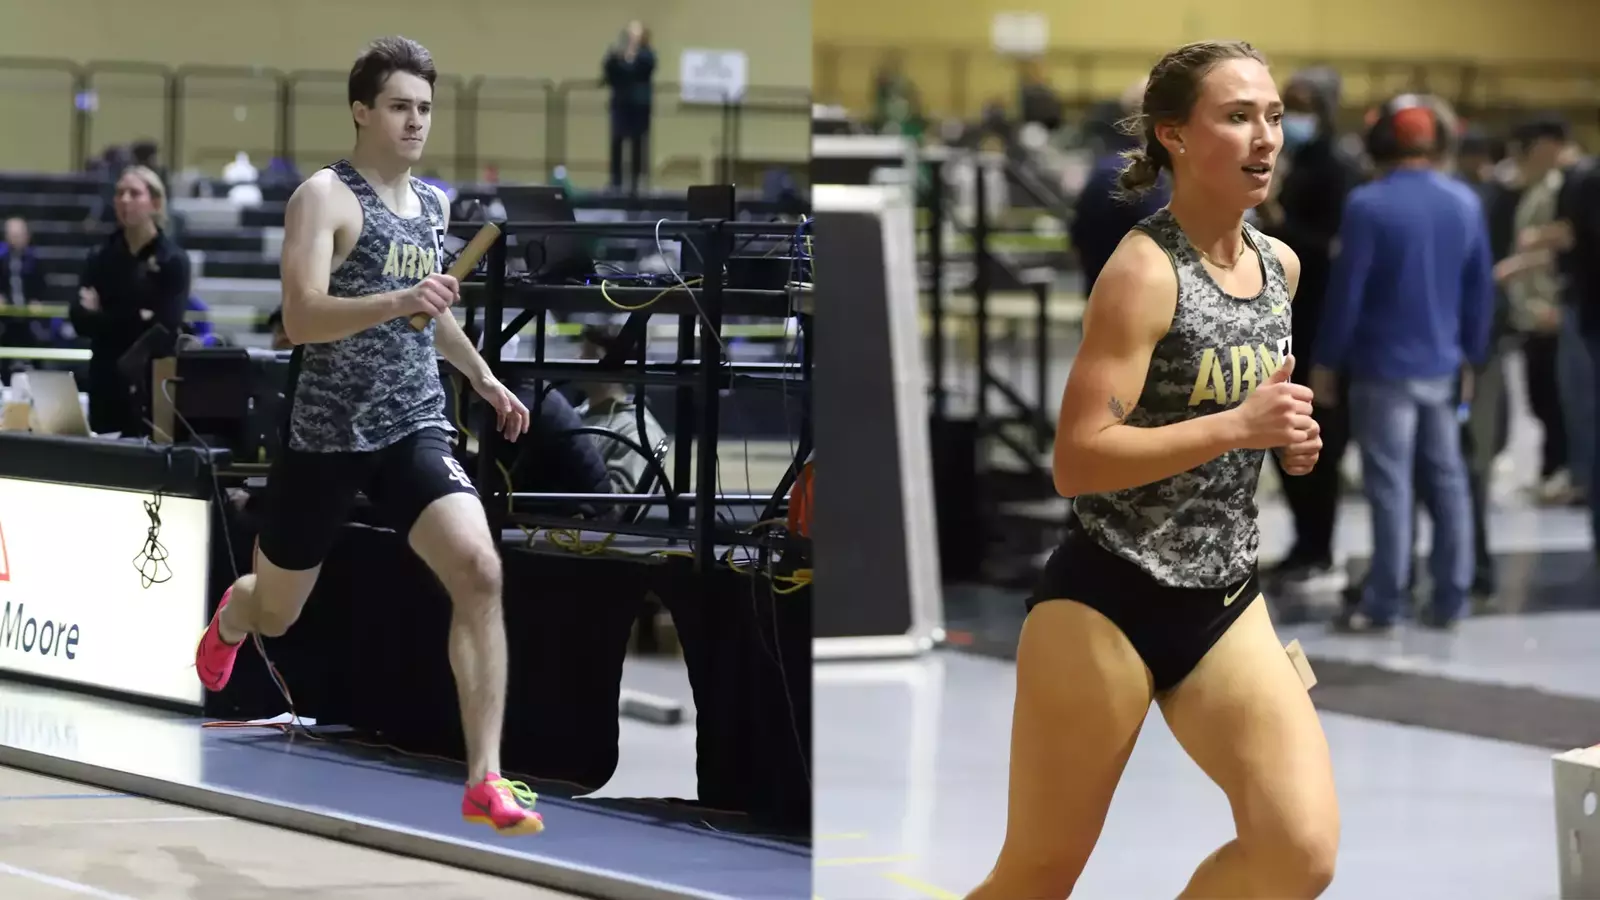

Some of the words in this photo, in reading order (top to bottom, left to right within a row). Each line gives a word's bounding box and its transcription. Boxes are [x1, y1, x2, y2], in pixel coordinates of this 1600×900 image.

[381, 240, 436, 280] ARM
[1188, 342, 1283, 406] ARM
[0, 600, 80, 660] Moore
